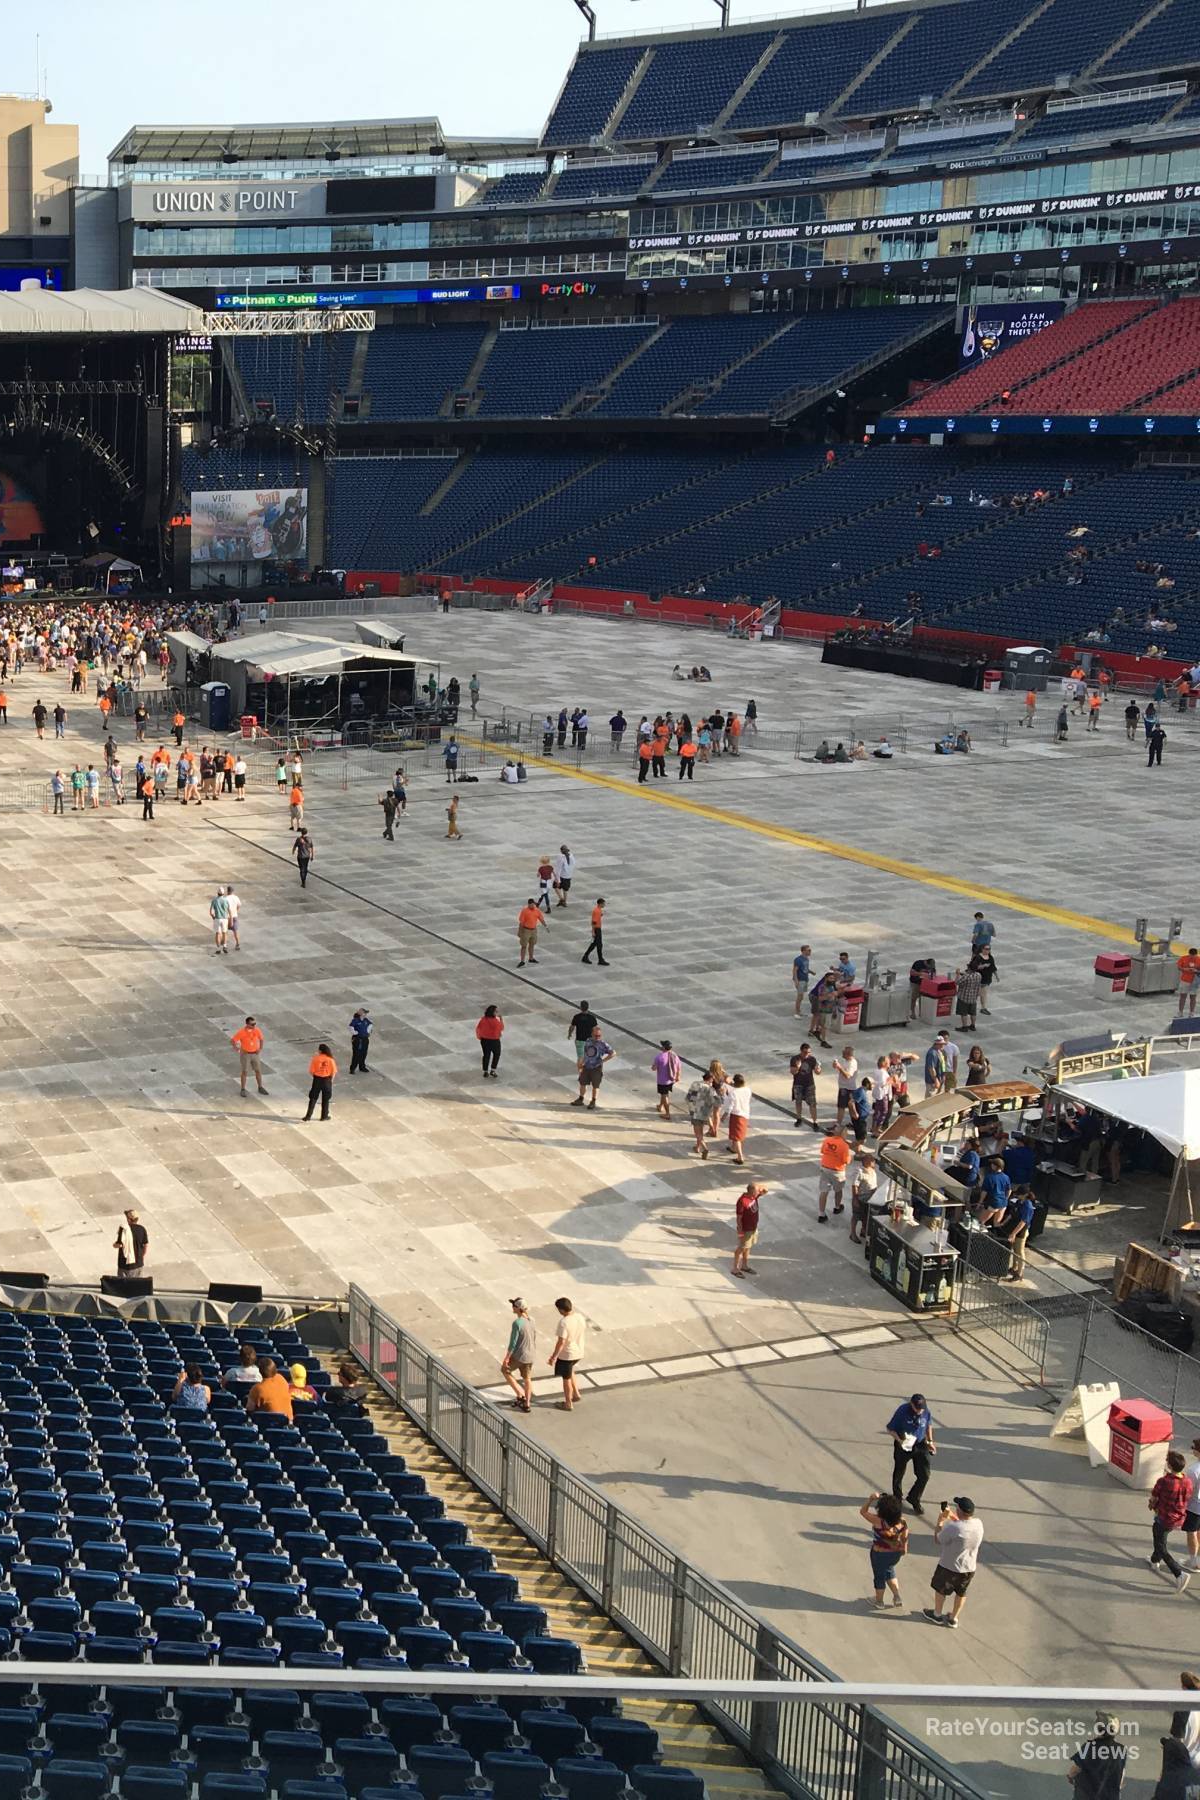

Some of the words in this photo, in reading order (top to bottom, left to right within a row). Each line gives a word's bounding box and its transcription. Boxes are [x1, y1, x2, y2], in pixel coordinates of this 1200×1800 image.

[156, 192, 214, 210] UNION
[239, 190, 298, 210] POINT
[1125, 190, 1168, 202] DUNKIN'
[1060, 196, 1101, 210] DUNKIN'
[936, 210, 973, 222] DUNKIN'
[996, 204, 1036, 216] DUNKIN'
[822, 222, 856, 234] DUNKIN'
[878, 216, 914, 228] DUNKIN'
[704, 232, 741, 243] DUNKIN'
[762, 228, 799, 238] DUNKIN'
[644, 237, 682, 247] DUNKIN'
[542, 284, 572, 296] Party
[574, 282, 596, 295] City
[232, 296, 276, 304] Putnam
